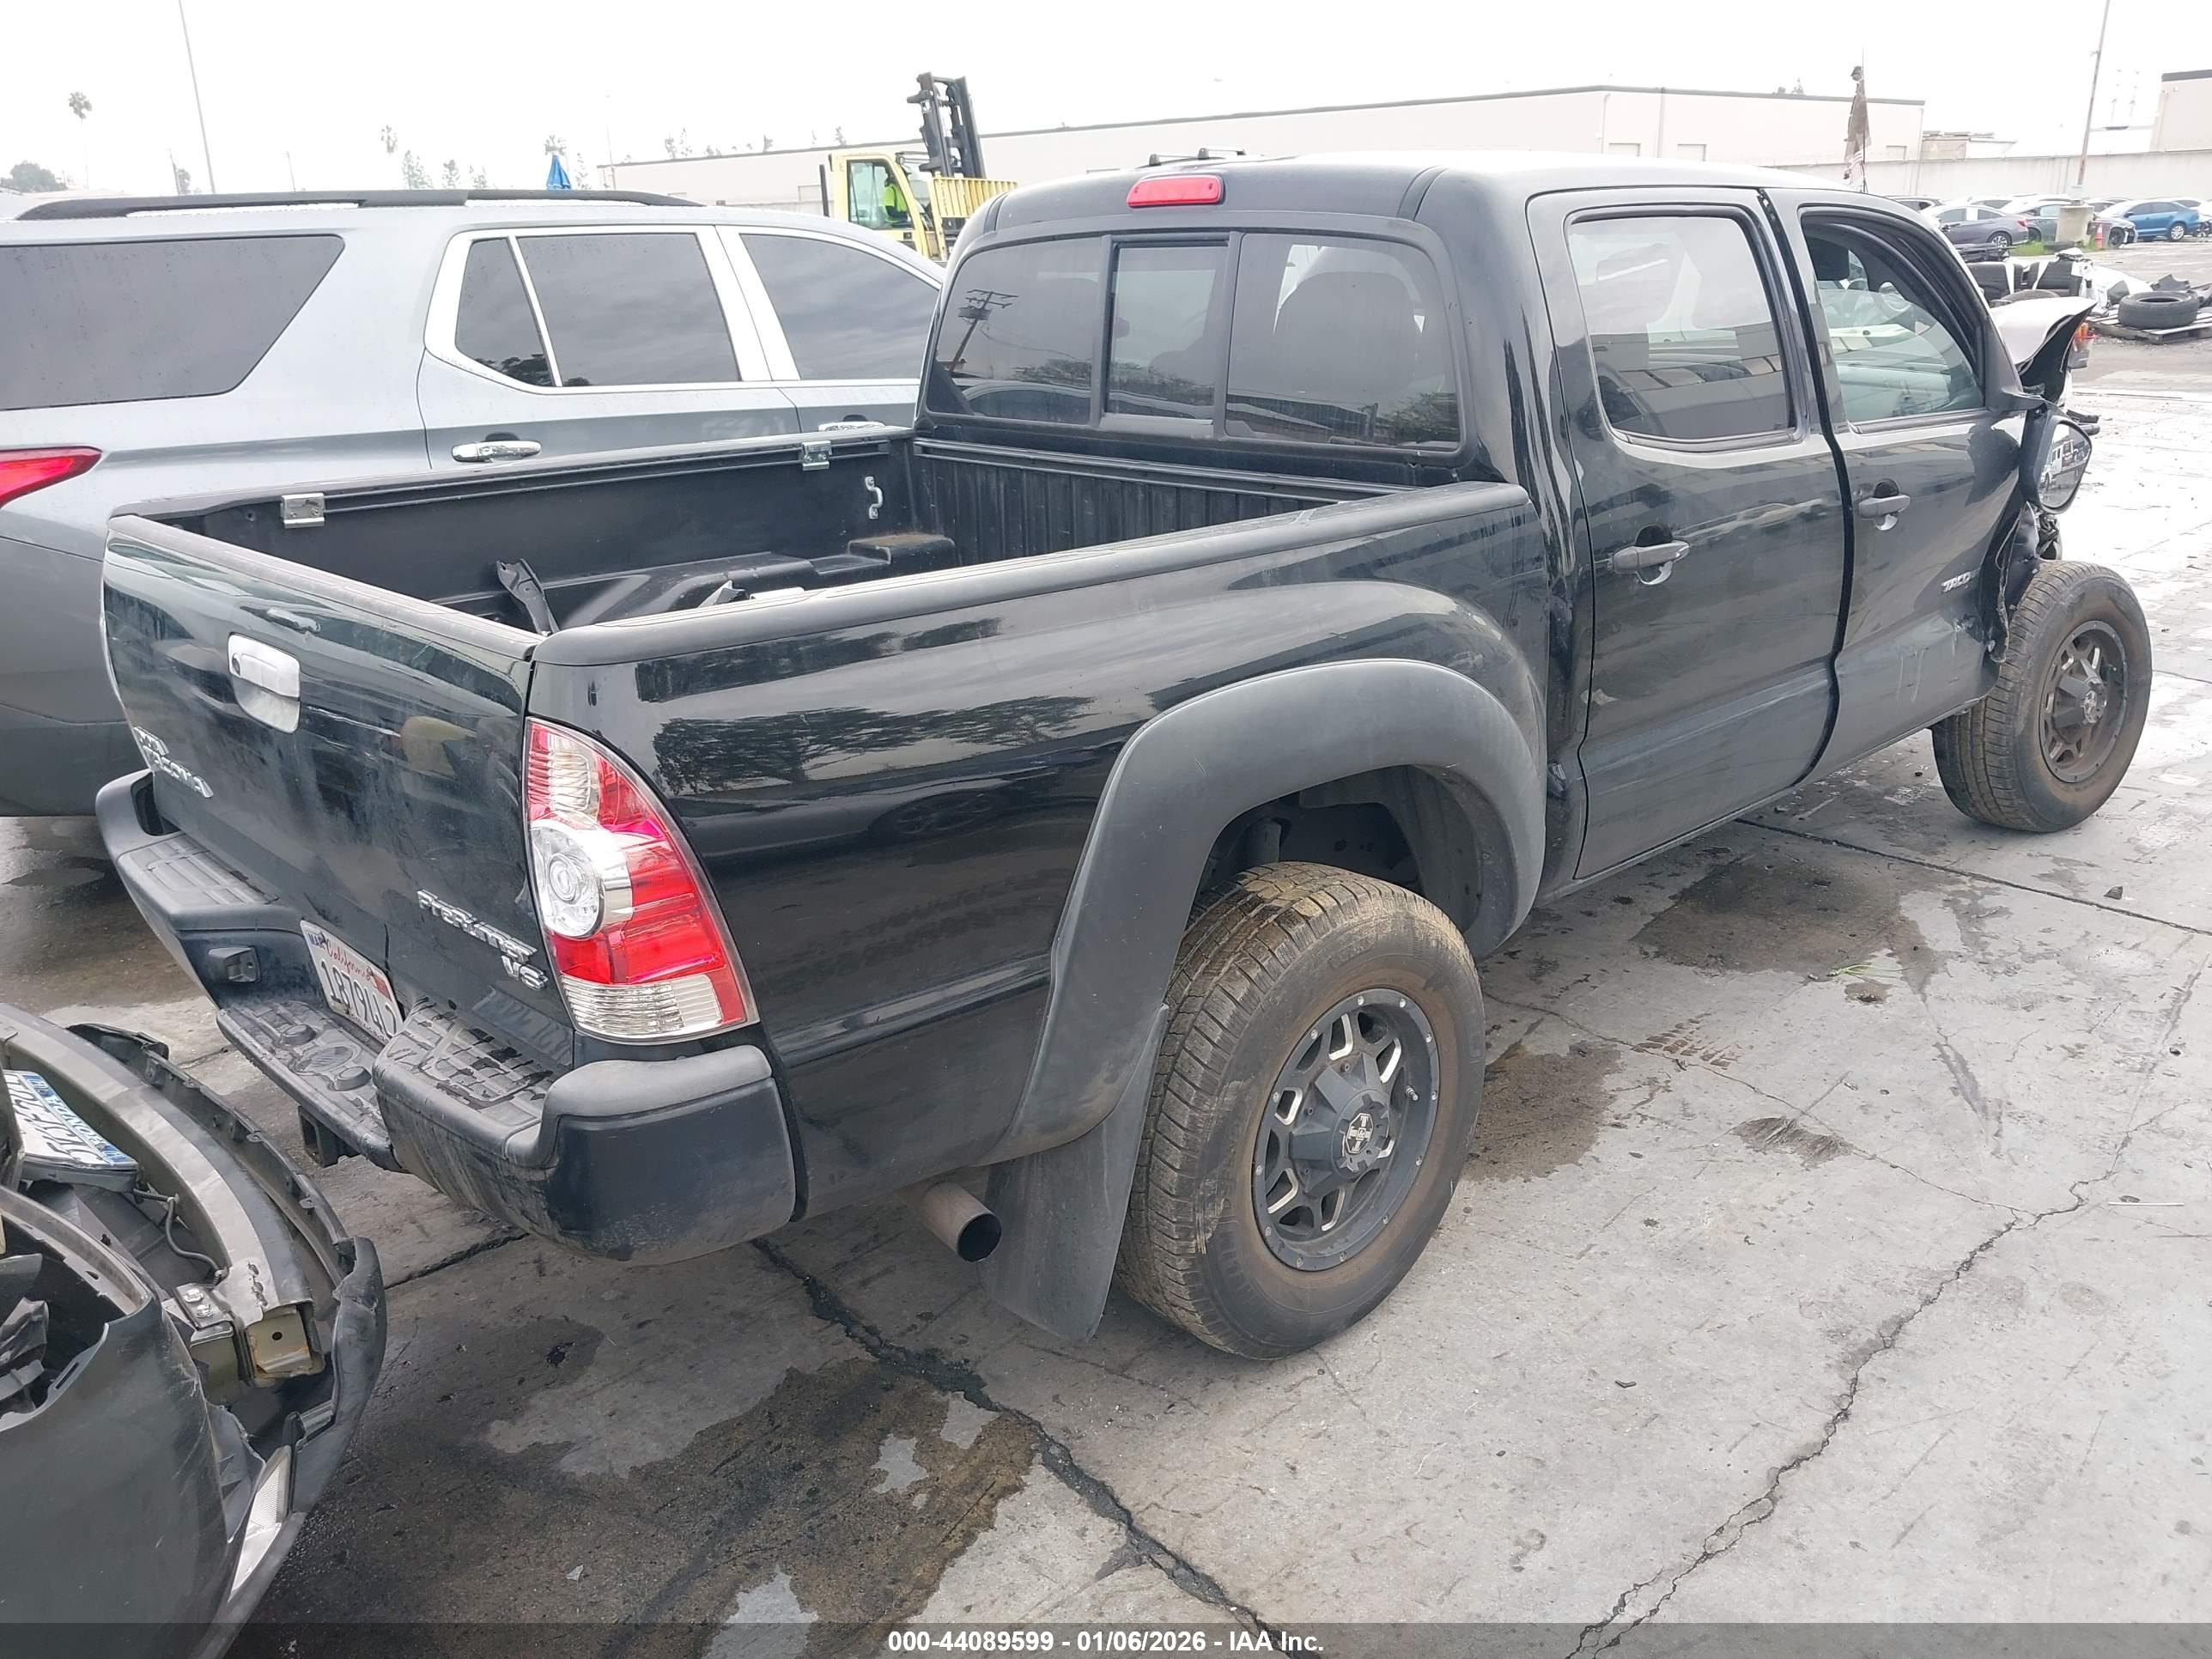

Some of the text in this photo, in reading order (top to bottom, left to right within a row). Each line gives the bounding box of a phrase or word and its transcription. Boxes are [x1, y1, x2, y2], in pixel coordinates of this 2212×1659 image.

[1942, 568, 1979, 592] TACO
[143, 745, 214, 798] TACOMA
[501, 954, 549, 991] V6
[46, 1098, 106, 1148] HONDA
